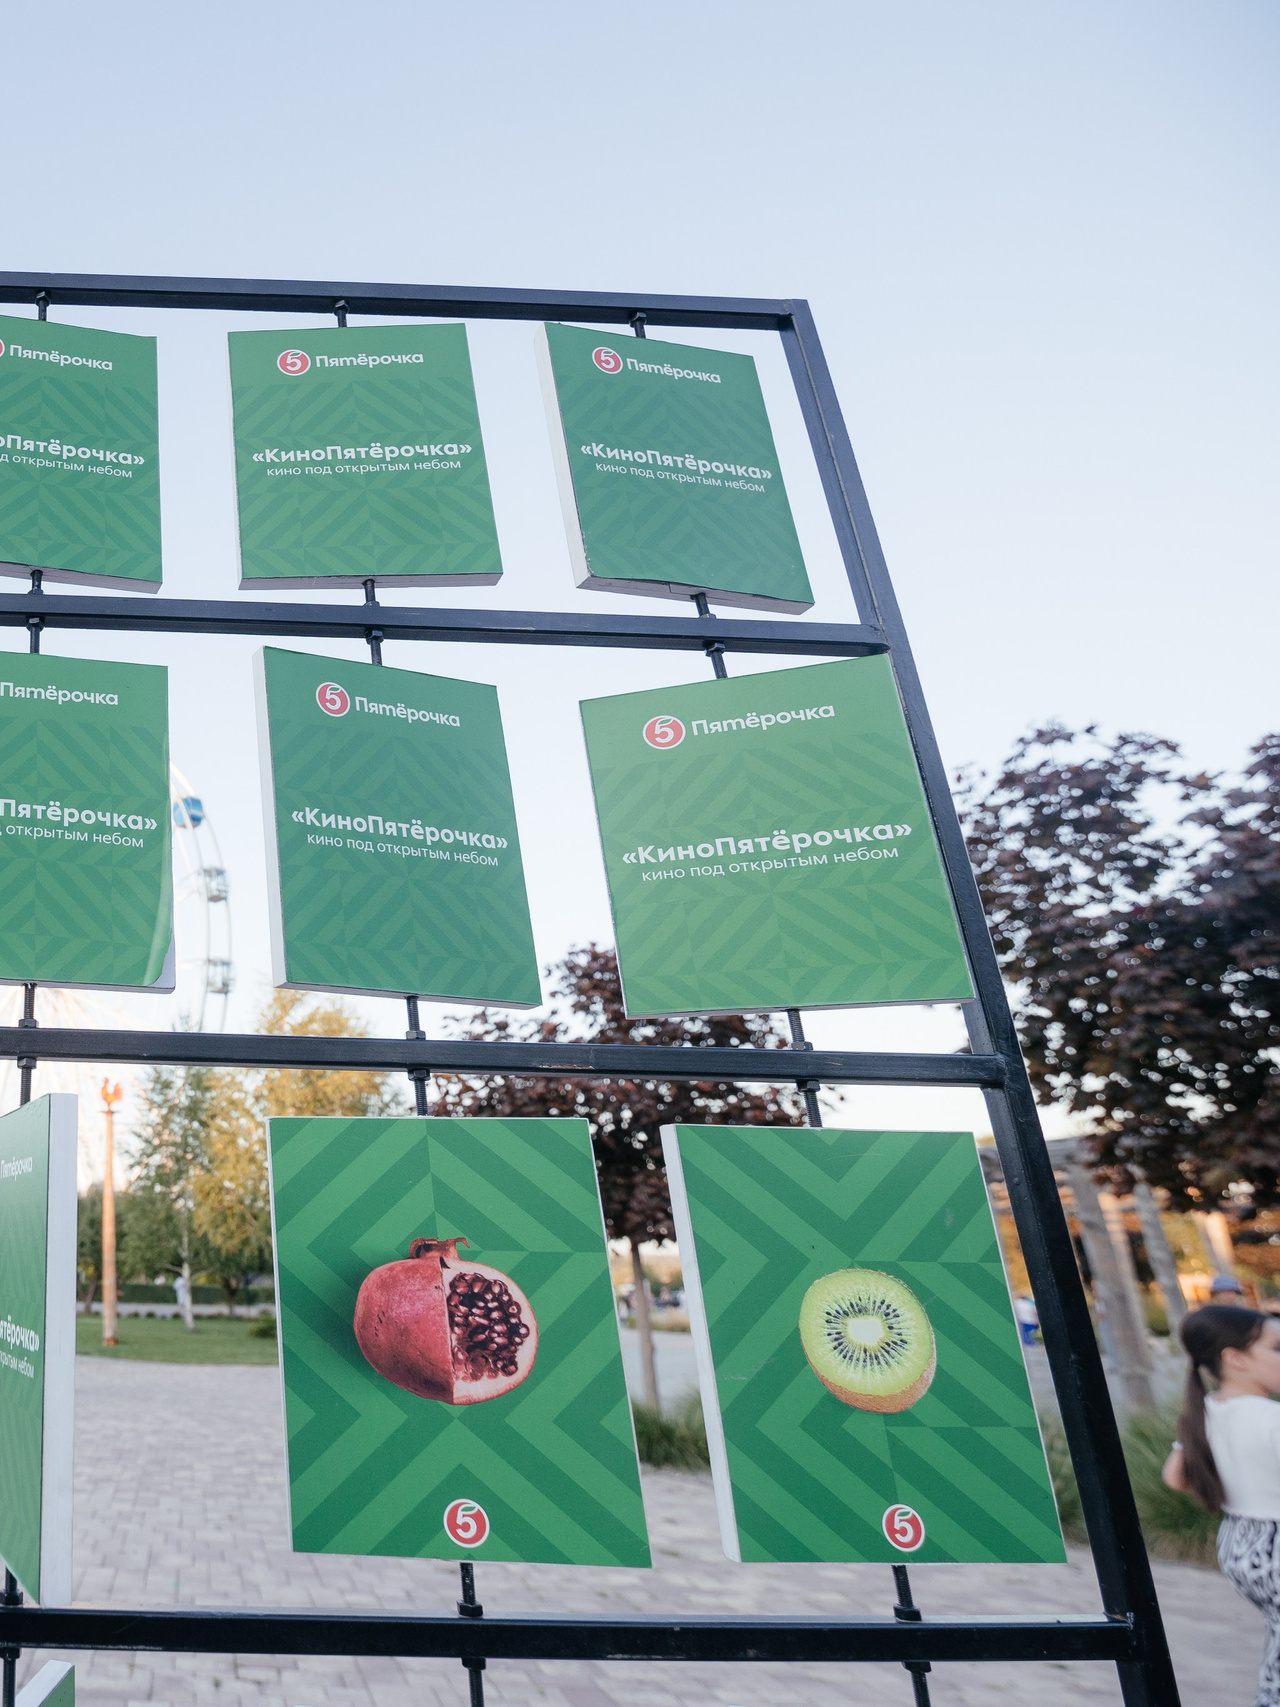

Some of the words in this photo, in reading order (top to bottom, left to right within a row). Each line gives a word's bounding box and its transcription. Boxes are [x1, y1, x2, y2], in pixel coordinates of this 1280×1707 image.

[10, 345, 112, 370] Пятёрочка
[316, 354, 423, 368] Пятёрочка
[627, 358, 721, 383] Пятёрочка
[253, 443, 472, 462] «КиноПятёрочка»
[581, 443, 772, 478] «КиноПятёрочка»
[13, 456, 83, 471] открытым
[89, 466, 132, 477] небом
[306, 467, 332, 475] под
[335, 463, 409, 474] открытым
[414, 459, 460, 469] небом
[596, 463, 627, 473] кино
[630, 468, 654, 478] под
[657, 471, 721, 486] открытым
[725, 480, 764, 492] небом
[0, 682, 118, 705] Пятёрочка
[355, 697, 460, 726] Пятёрочка
[692, 706, 835, 735] Пятёрочка
[6, 826, 87, 841] открытым
[94, 833, 143, 847] небом
[292, 807, 507, 848] «КиноПятёрочка»
[308, 834, 342, 847] кино
[347, 839, 374, 853] под
[377, 843, 450, 860] открытым
[454, 852, 498, 866] небом
[623, 824, 912, 864] «КиноПятёрочка»
[642, 869, 685, 881] кино
[690, 865, 725, 876] под
[729, 855, 828, 873] открытым
[834, 847, 898, 862] небом
[1, 1155, 32, 1181] Пятёрочка
